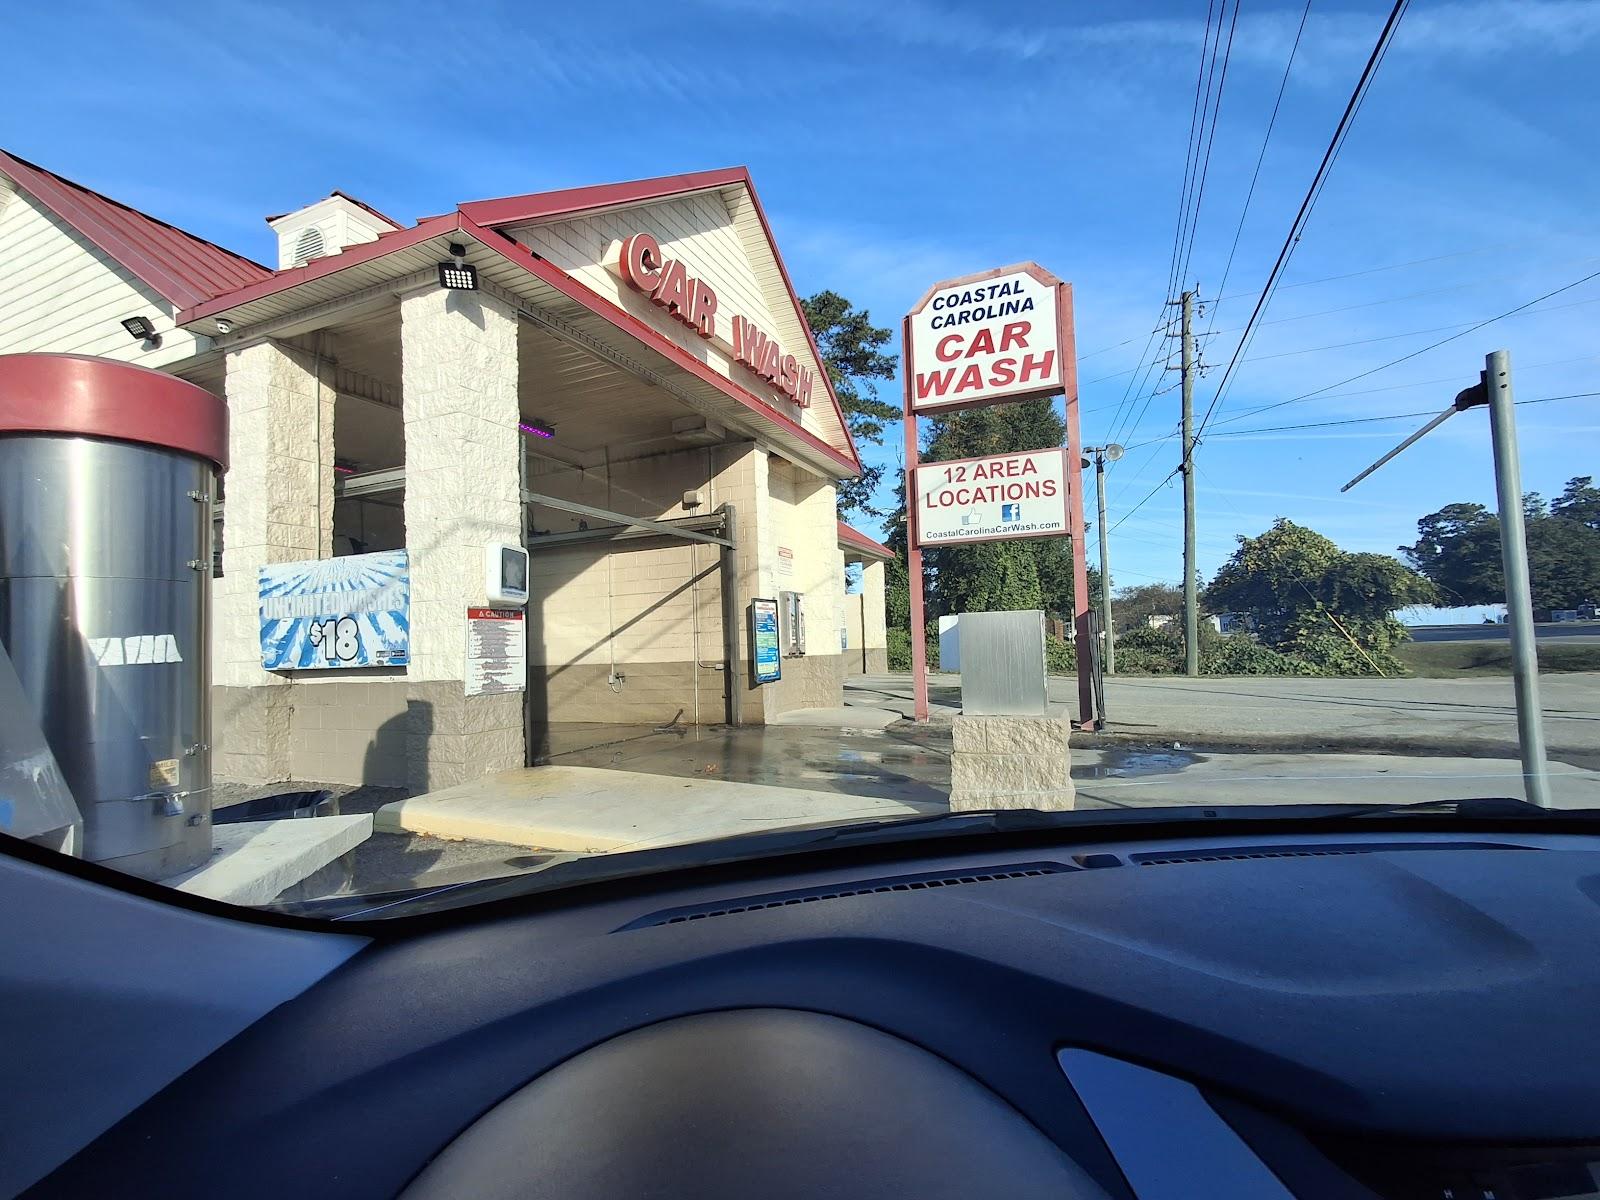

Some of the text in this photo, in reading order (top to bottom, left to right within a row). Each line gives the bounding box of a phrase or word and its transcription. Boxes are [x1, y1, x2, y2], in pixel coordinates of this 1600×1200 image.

[932, 280, 1025, 311] COASTAL
[619, 232, 813, 408] CAR WASH
[931, 297, 1034, 330] CAROLINA
[935, 320, 1032, 363] CAR
[916, 349, 1055, 399] WASH
[944, 458, 1037, 484] 12 AREA
[926, 479, 1056, 509] LOCATIONS
[926, 522, 1060, 539] CoastalCarolinaCarWash.com
[262, 591, 341, 619] UNLIMITED
[485, 610, 515, 619] CAUTION
[309, 616, 360, 662] $18
